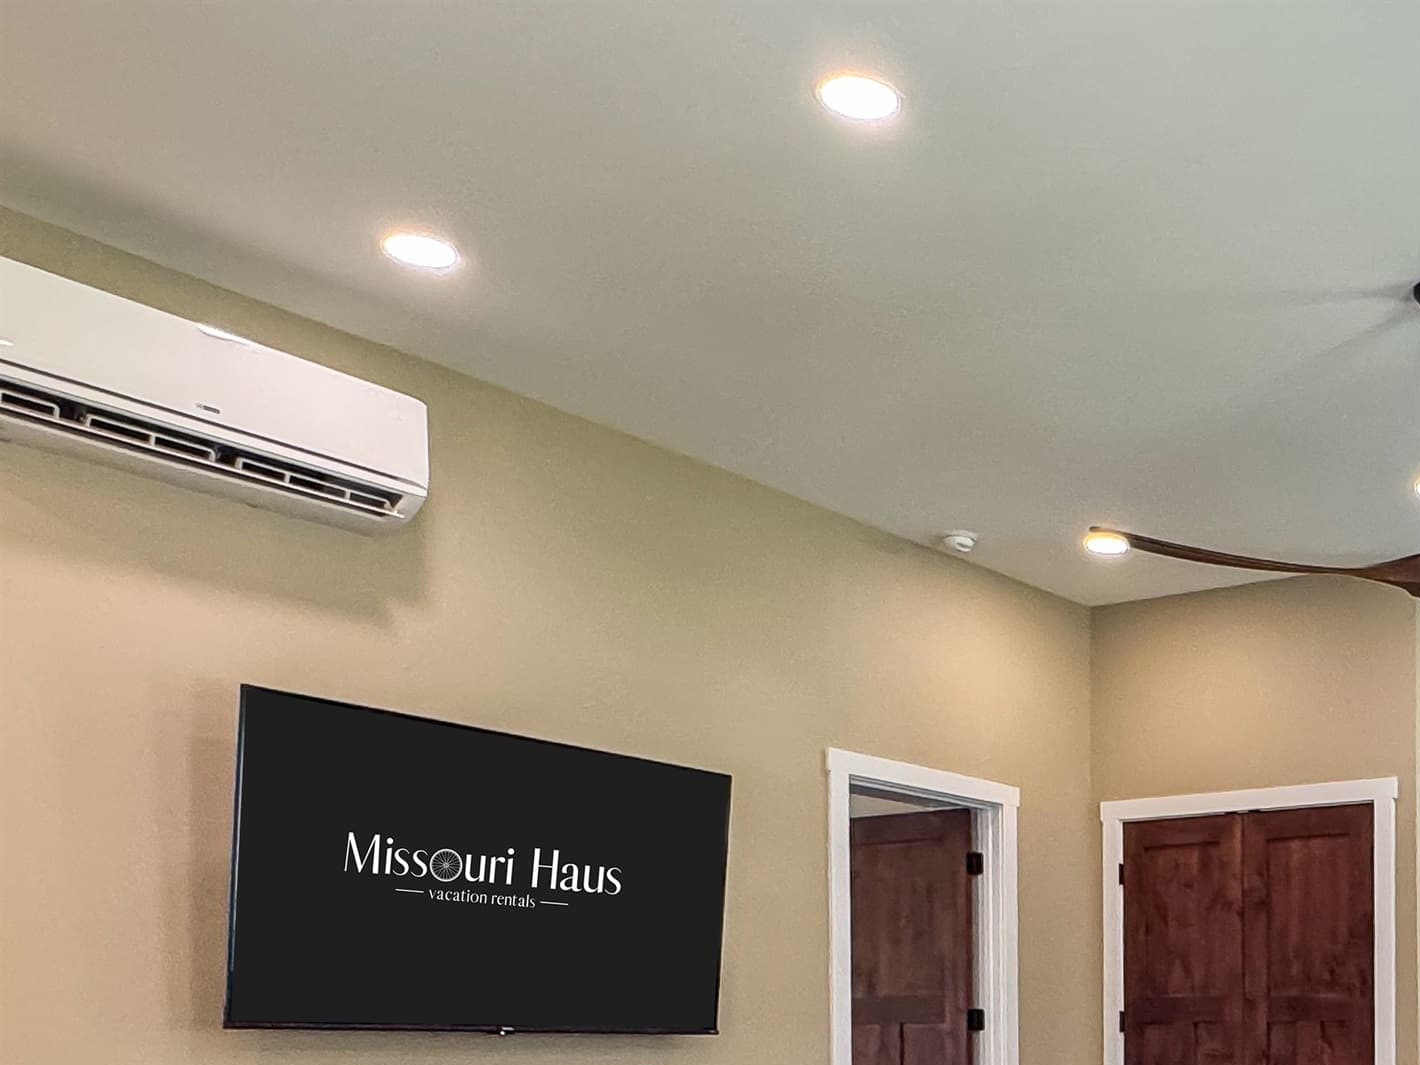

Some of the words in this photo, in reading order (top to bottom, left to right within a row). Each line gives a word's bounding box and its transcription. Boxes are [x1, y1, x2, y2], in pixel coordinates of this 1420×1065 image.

[343, 831, 515, 884] Missouri
[531, 847, 622, 896] Haus
[428, 888, 488, 905] vacation
[490, 893, 536, 909] rentals
